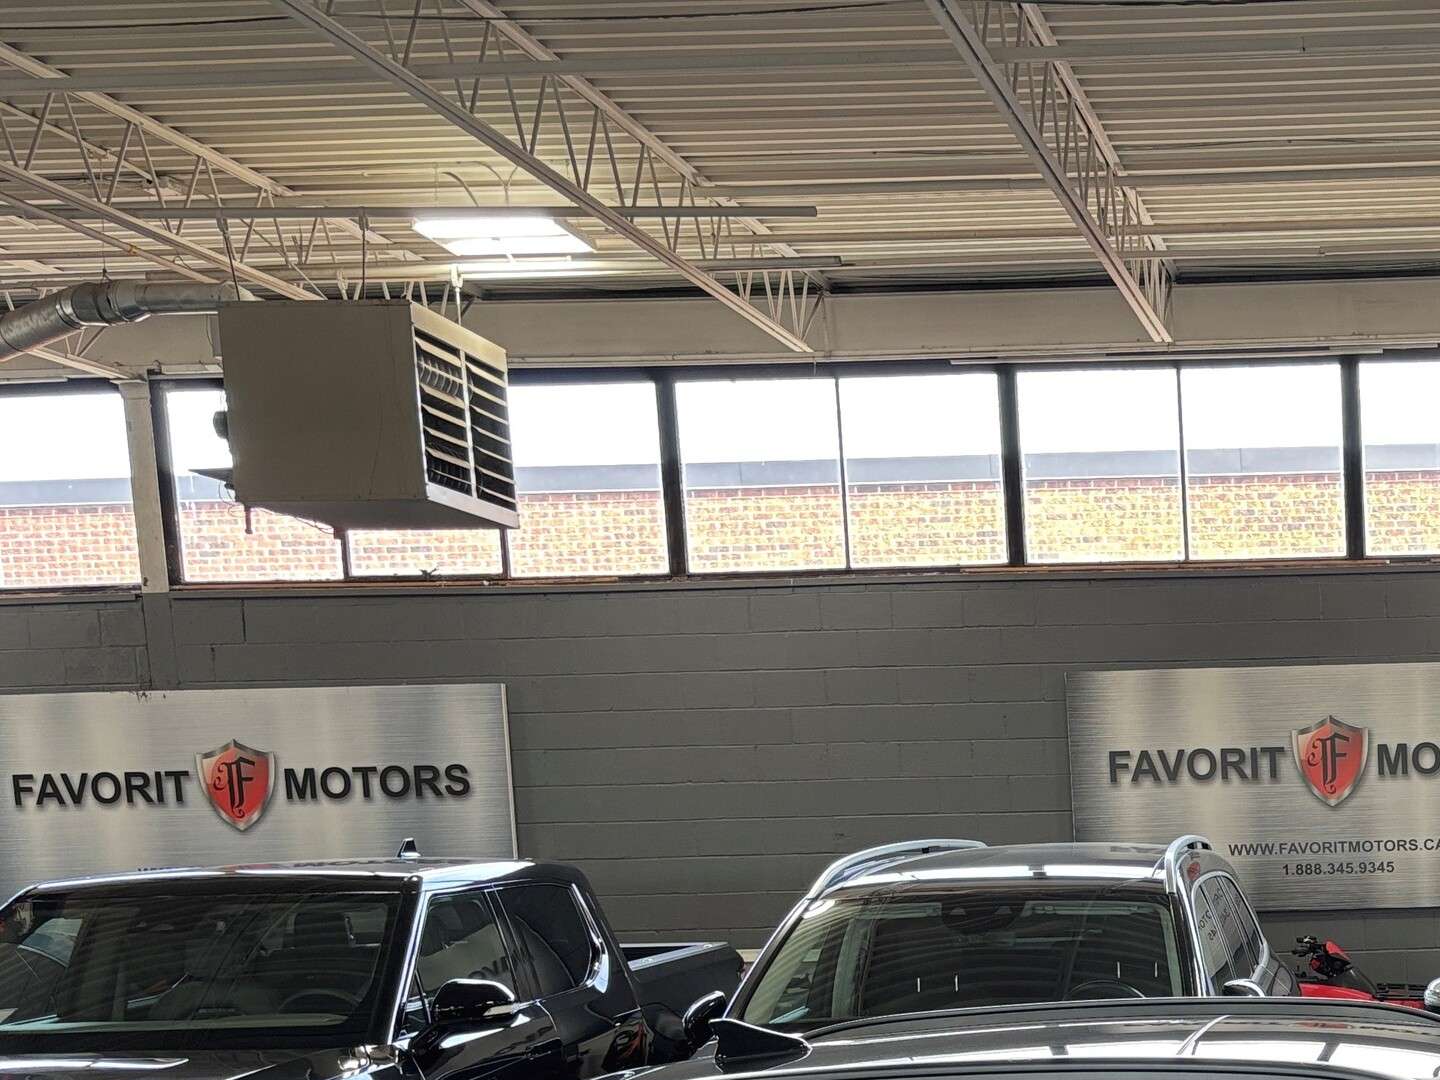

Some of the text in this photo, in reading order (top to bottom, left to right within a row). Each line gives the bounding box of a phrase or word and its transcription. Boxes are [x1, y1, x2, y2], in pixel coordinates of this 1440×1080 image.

[1108, 746, 1286, 783] FAVORIT
[12, 770, 190, 806] FAVORIT
[284, 763, 471, 801] MOTORS
[1282, 861, 1395, 876] 1.888.345.9345
